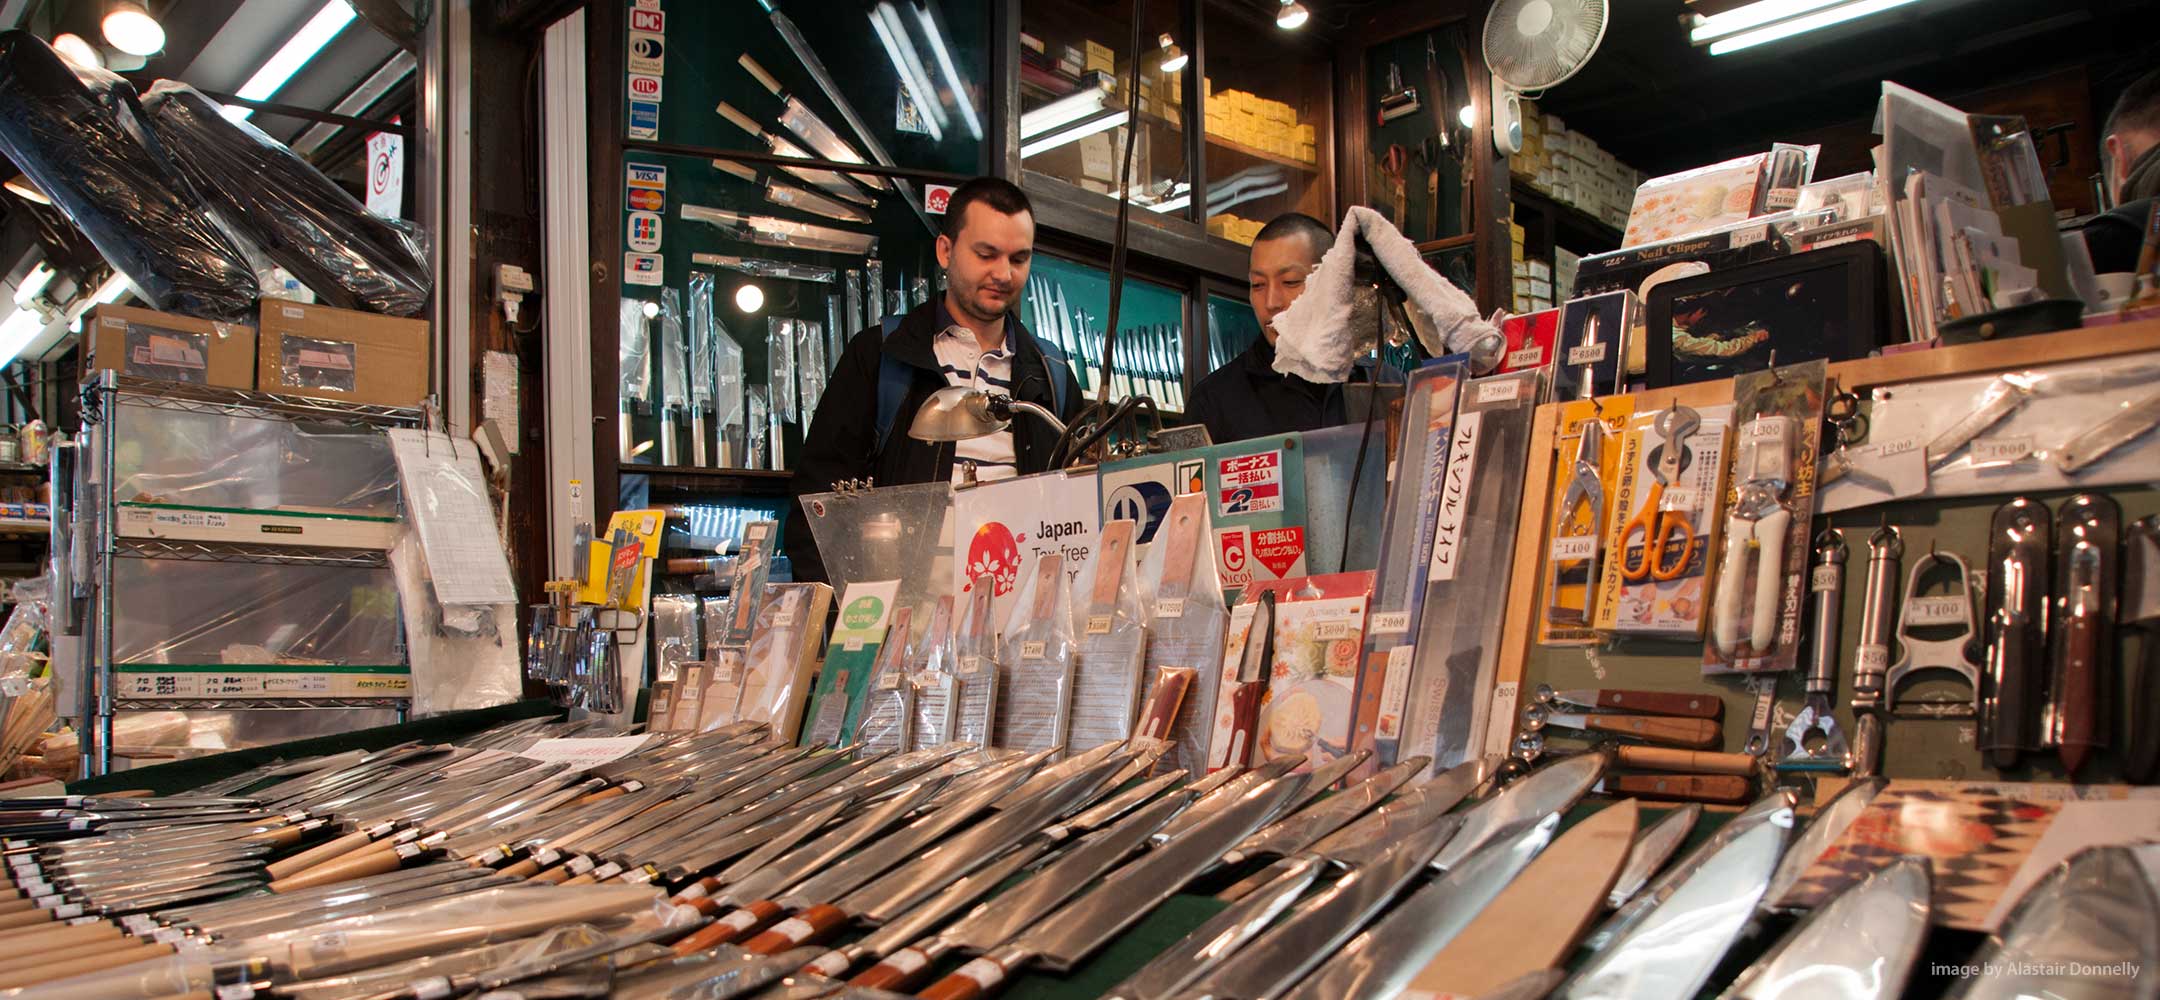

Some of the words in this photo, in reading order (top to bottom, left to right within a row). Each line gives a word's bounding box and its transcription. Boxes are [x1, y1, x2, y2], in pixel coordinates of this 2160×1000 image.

[635, 12, 660, 30] DC
[635, 171, 658, 181] VISA
[1637, 248, 1663, 261] Nail
[1666, 239, 1711, 255] Clipper
[1518, 351, 1539, 361] 6900
[1882, 440, 1912, 453] 1200
[1226, 455, 1270, 472] ボーナス
[1226, 470, 1272, 485] 一括払い
[1037, 520, 1088, 541] Japan.
[1257, 530, 1297, 546] 分割払い
[1061, 544, 1089, 562] free
[1564, 542, 1591, 554] 1400
[1220, 568, 1253, 584] NICOS
[1382, 617, 1406, 628] 2000
